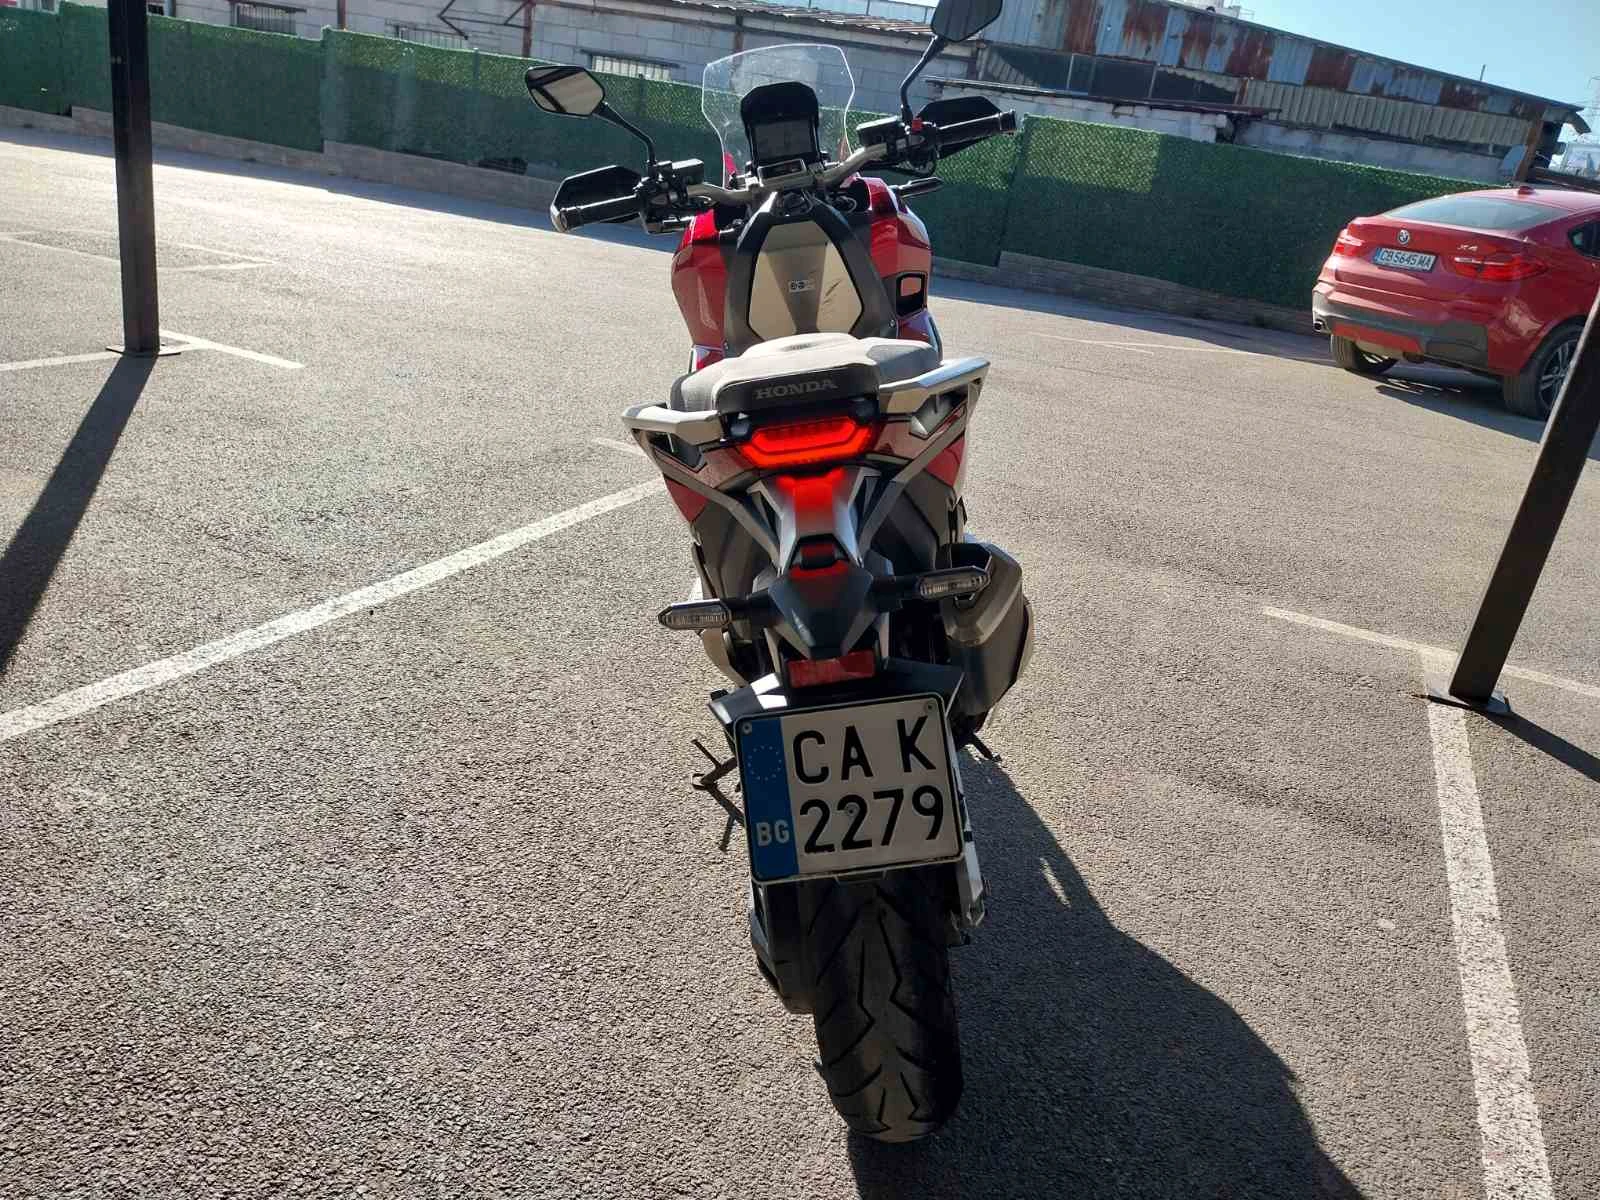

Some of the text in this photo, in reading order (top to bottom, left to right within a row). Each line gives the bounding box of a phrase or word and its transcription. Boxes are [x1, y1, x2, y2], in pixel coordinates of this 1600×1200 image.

[755, 379, 838, 400] HONDA
[897, 715, 936, 773] K
[756, 819, 790, 847] BG
[800, 785, 944, 854] 2279
